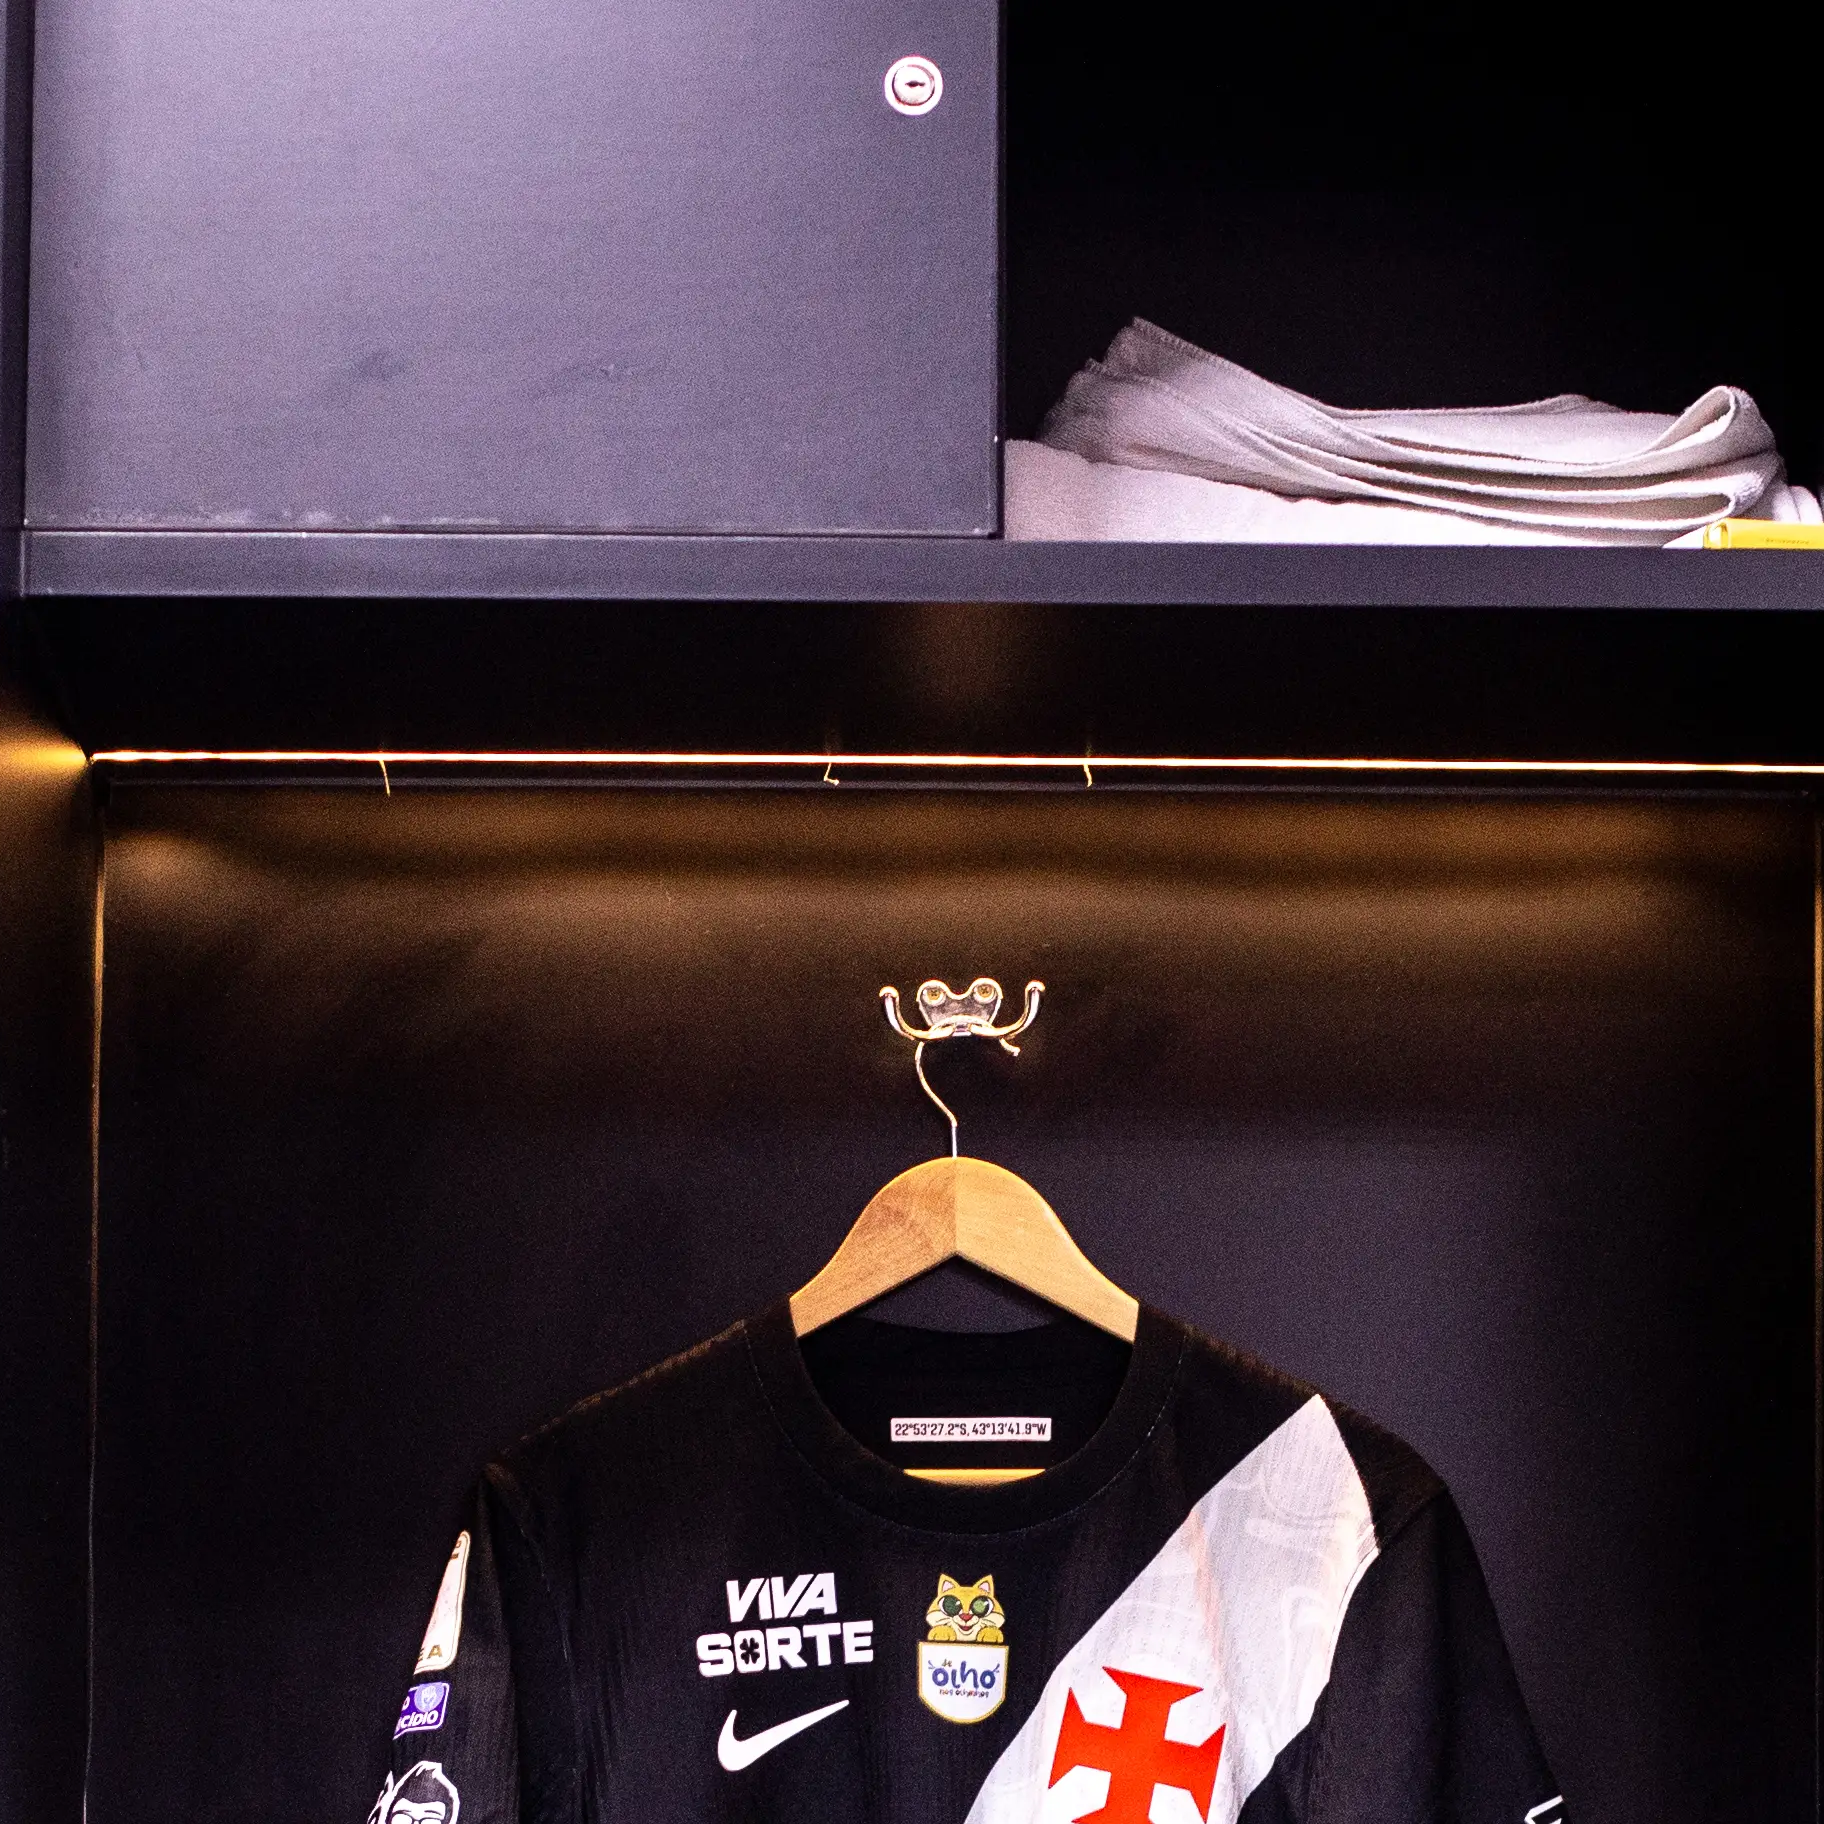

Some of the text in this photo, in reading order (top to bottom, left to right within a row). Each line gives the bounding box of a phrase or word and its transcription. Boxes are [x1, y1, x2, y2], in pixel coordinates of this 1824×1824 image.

[726, 1572, 838, 1623] VIVA
[695, 1619, 874, 1678] SORTE
[932, 1660, 996, 1690] olho
